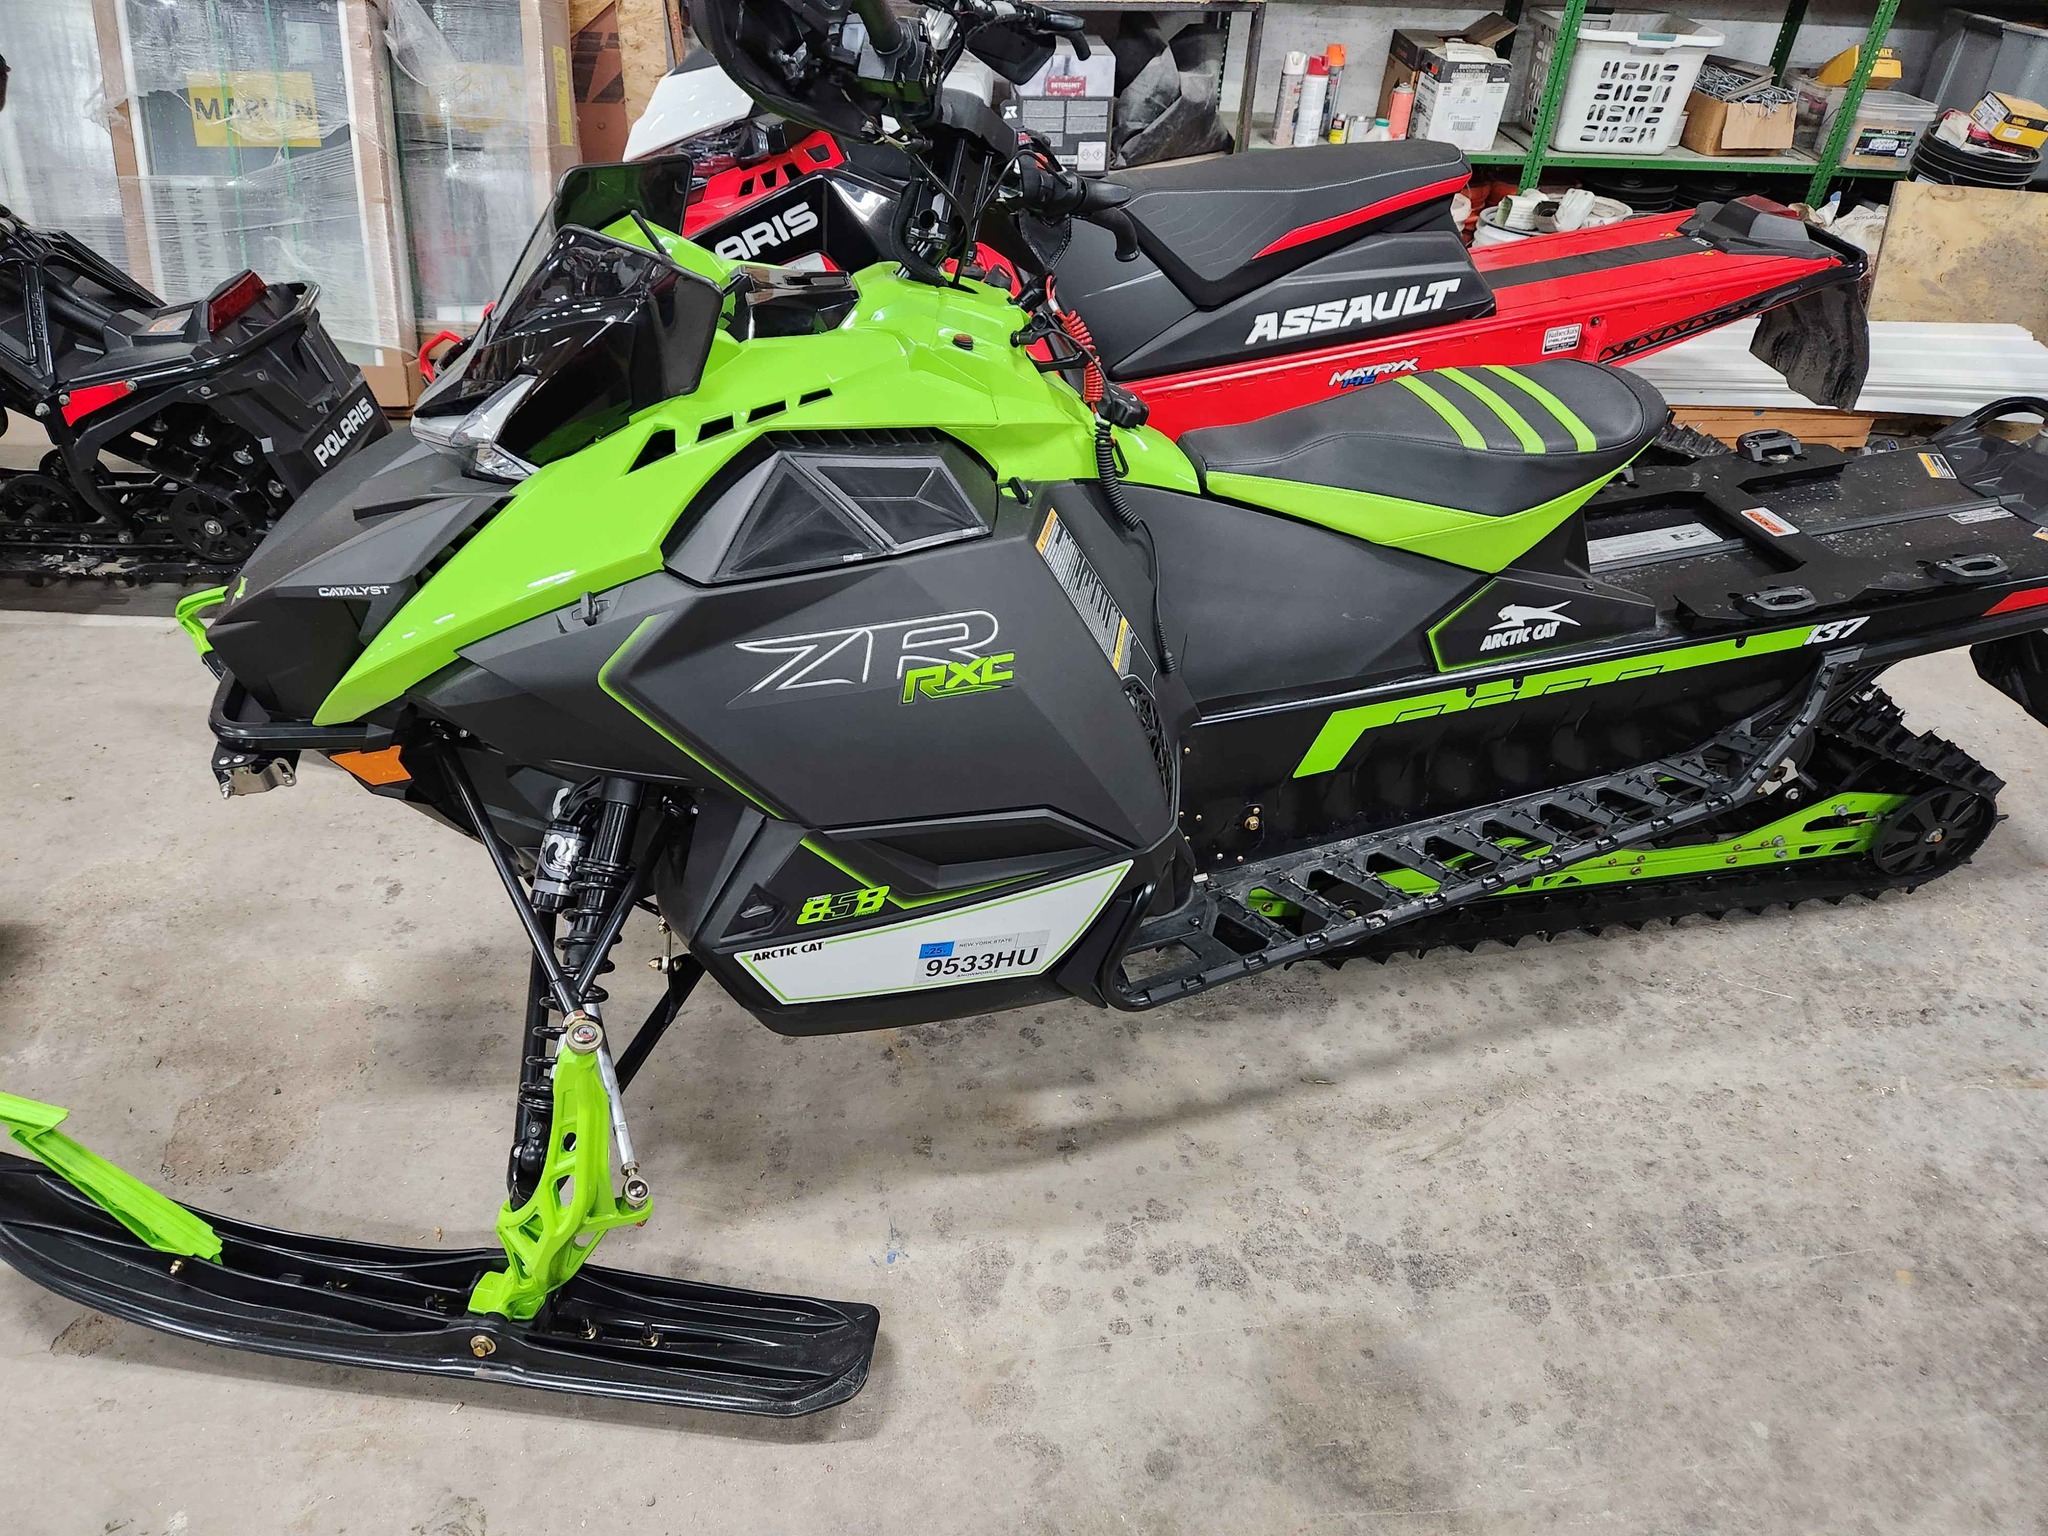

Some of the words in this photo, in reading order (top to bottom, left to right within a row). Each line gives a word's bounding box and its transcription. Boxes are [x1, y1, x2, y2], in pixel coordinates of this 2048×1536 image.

[714, 201, 819, 262] ARIS
[1244, 278, 1462, 345] ASSAULT
[1328, 357, 1419, 387] MATRYX
[313, 396, 374, 468] POLARIS
[318, 585, 391, 597] CATALYST
[1480, 627, 1532, 652] ARCTIC
[1532, 620, 1561, 641] CAT
[1803, 615, 1871, 646] 137
[902, 652, 1015, 705] RXC
[796, 885, 891, 925] 858
[753, 946, 798, 962] ARCTIC
[801, 941, 826, 955] CAT
[925, 947, 1039, 977] 9533HU
[930, 946, 943, 954] 25
[957, 969, 998, 978] SNOWMOBILE
